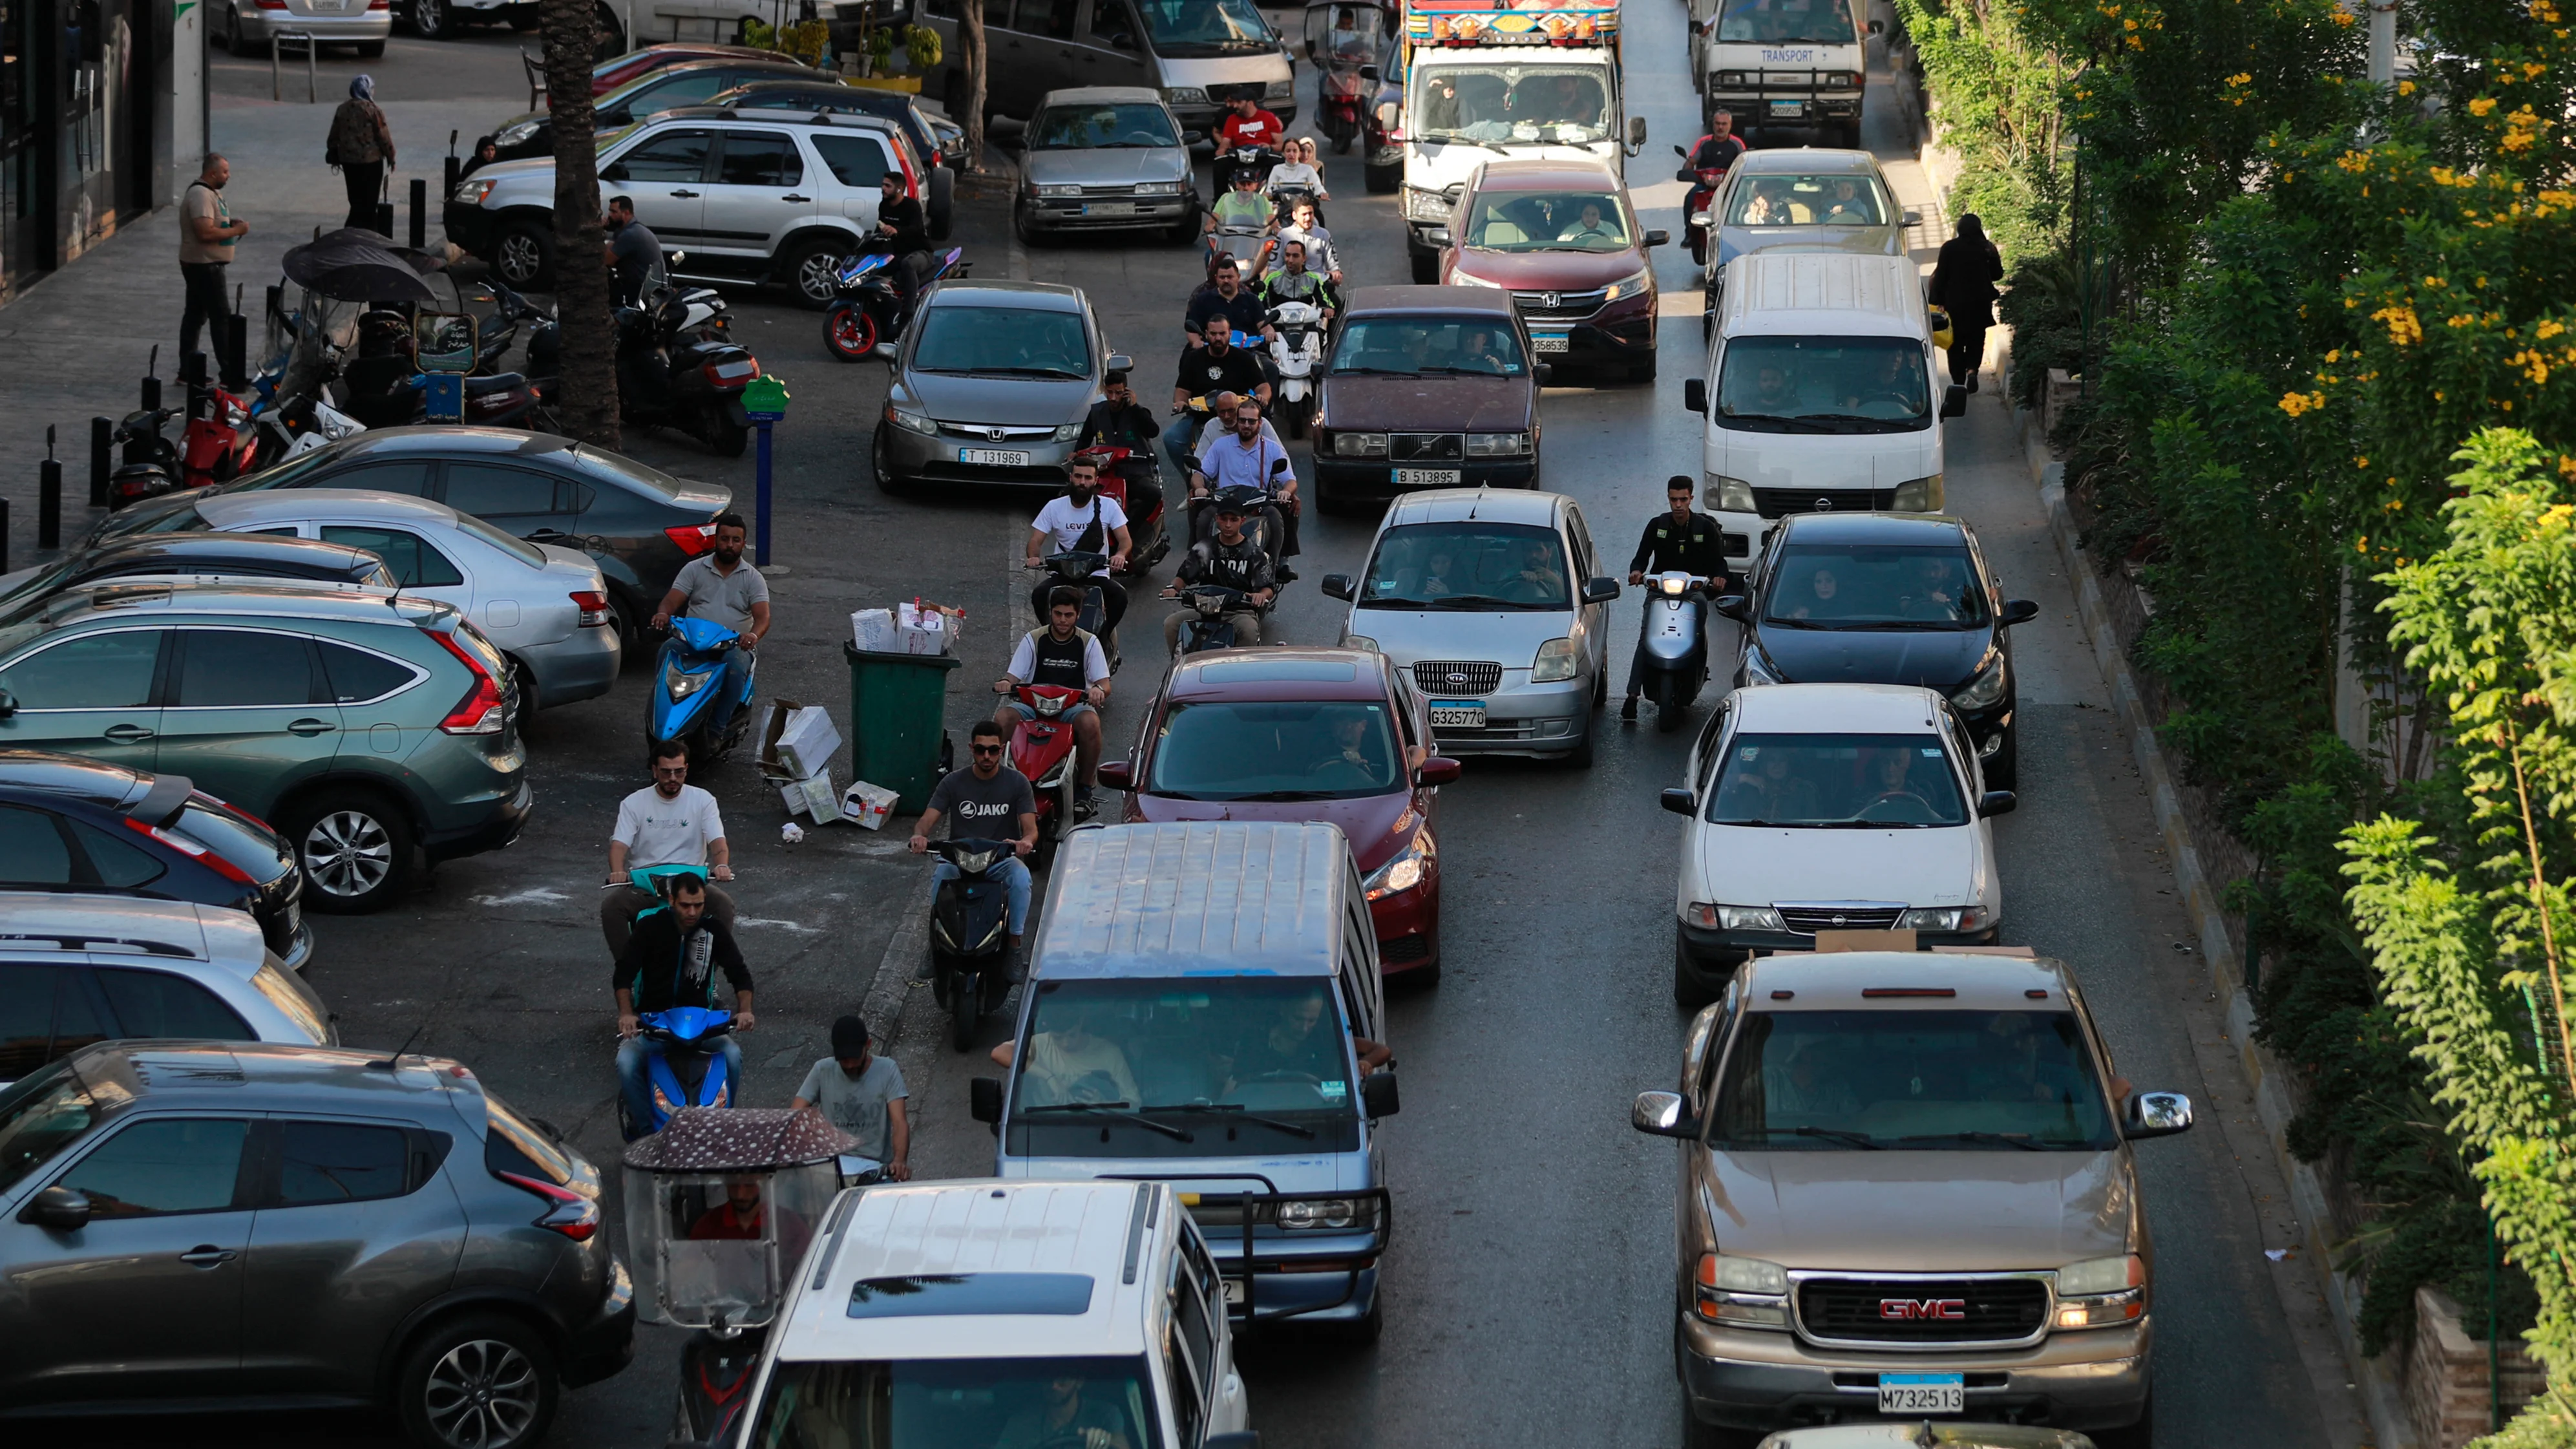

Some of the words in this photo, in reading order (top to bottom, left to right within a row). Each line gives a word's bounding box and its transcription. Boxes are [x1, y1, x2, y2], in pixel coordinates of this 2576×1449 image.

[1761, 50, 1813, 62] TRANSPORT
[969, 450, 976, 461] T
[984, 451, 1022, 464] 131969
[1400, 471, 1407, 481] B
[1413, 471, 1453, 483] 513895
[1210, 560, 1247, 575] ION
[1431, 711, 1484, 724] G325770
[977, 803, 1009, 816] JAKO
[696, 936, 706, 960] PUMA
[1880, 1299, 1965, 1318] GMC
[1881, 1389, 1961, 1408] M732513
